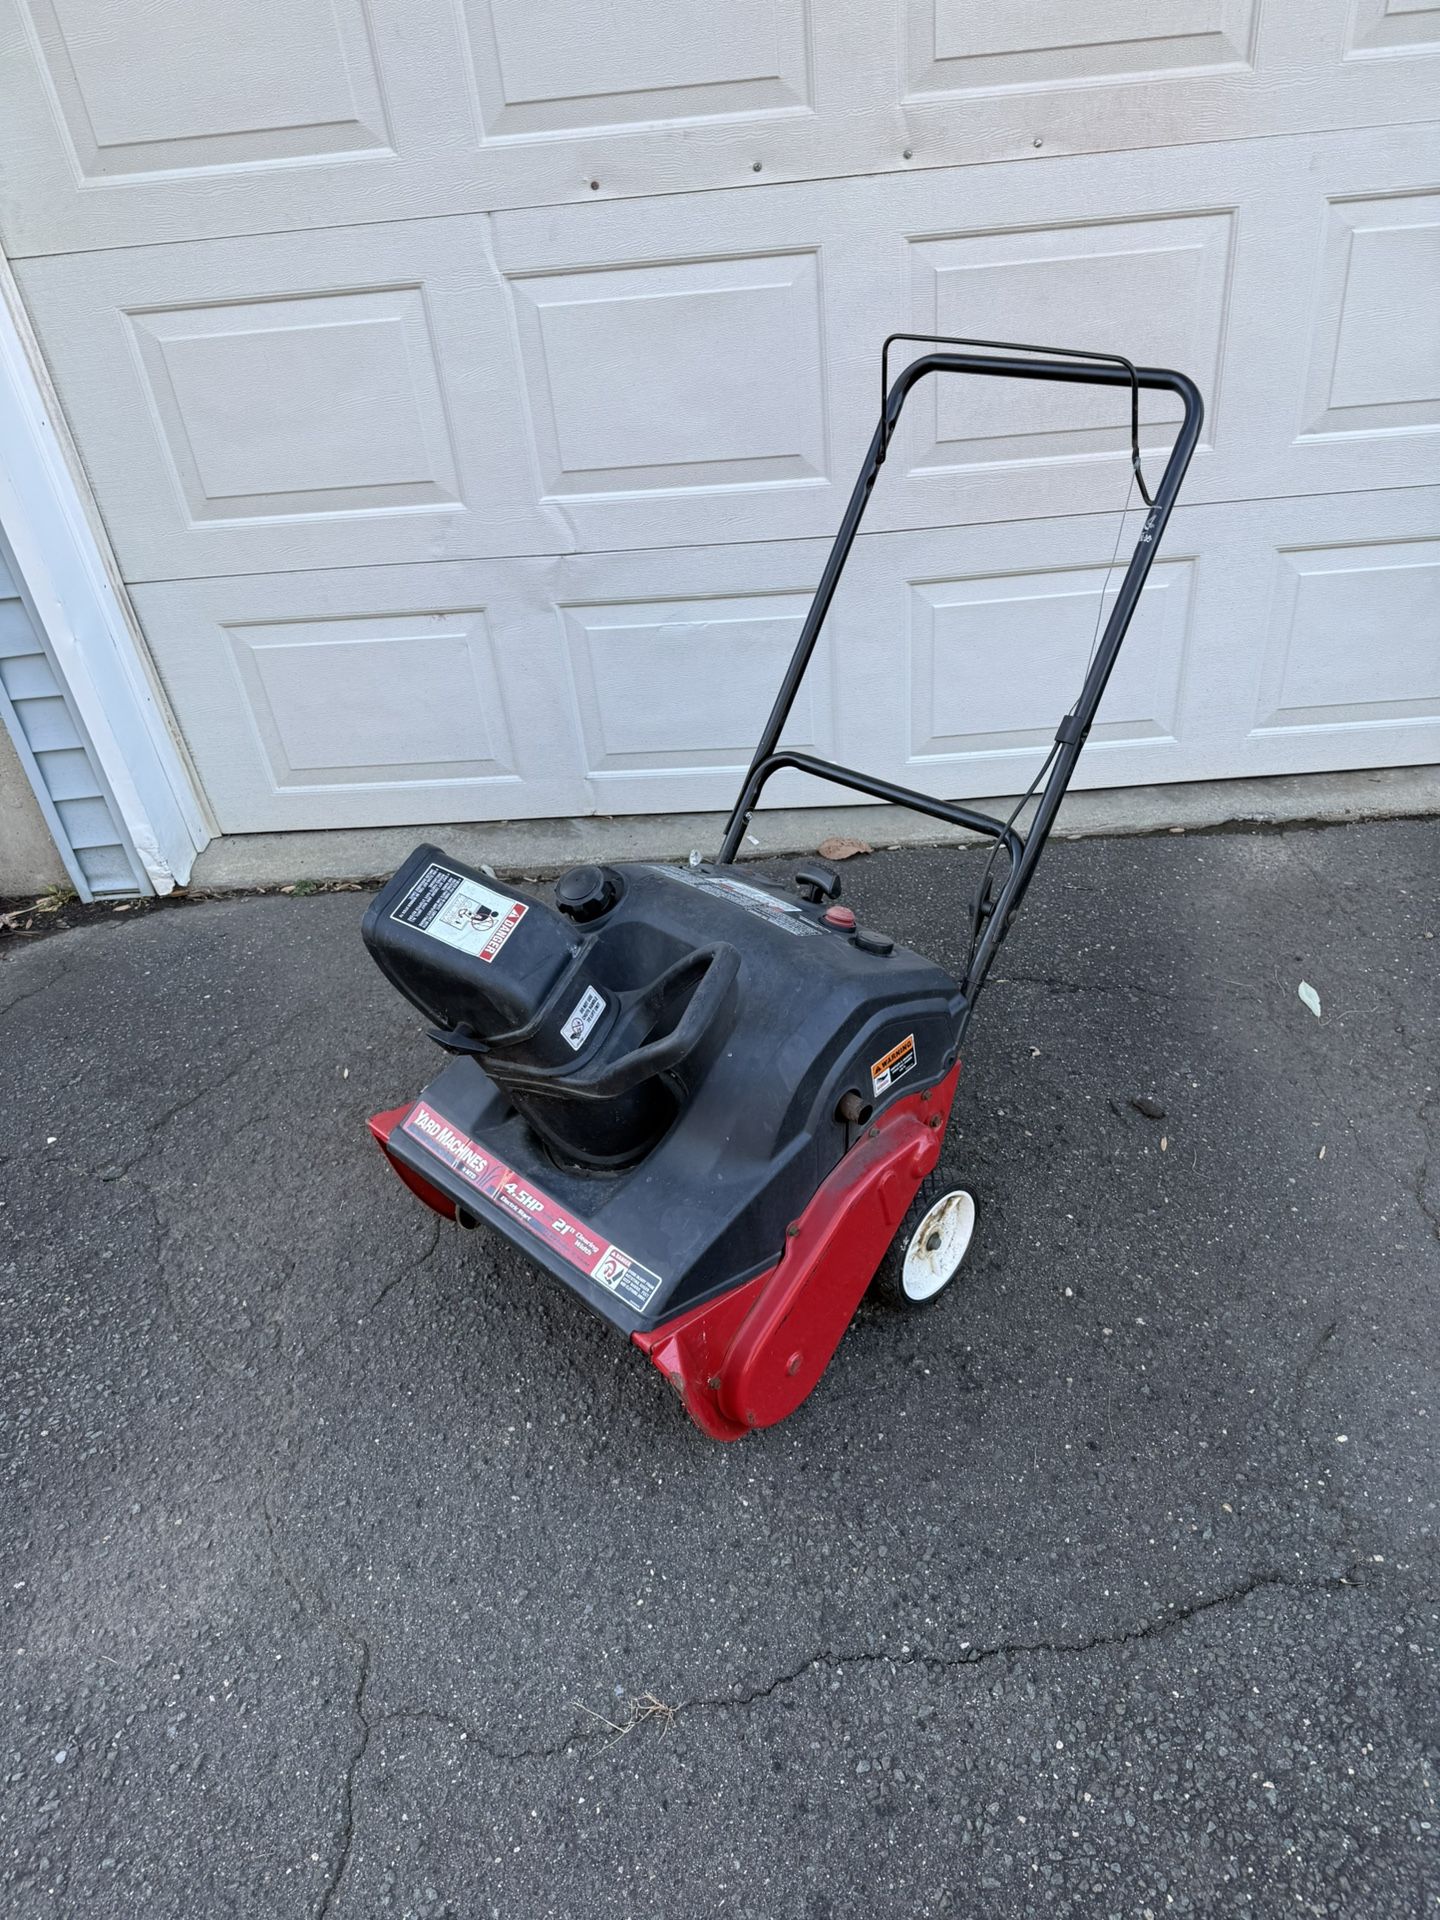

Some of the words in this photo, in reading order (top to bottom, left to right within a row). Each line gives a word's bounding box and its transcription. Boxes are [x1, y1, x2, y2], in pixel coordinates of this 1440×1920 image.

[485, 919, 514, 954] DANGER
[882, 1040, 912, 1068] WARNING
[414, 1109, 440, 1136] YARD
[436, 1127, 488, 1172] MACHINES
[500, 1196, 519, 1213] Electric
[517, 1208, 532, 1222] Start
[505, 1183, 545, 1212] 4.5HP
[574, 1240, 592, 1256] Width
[575, 1231, 600, 1253] Clearing
